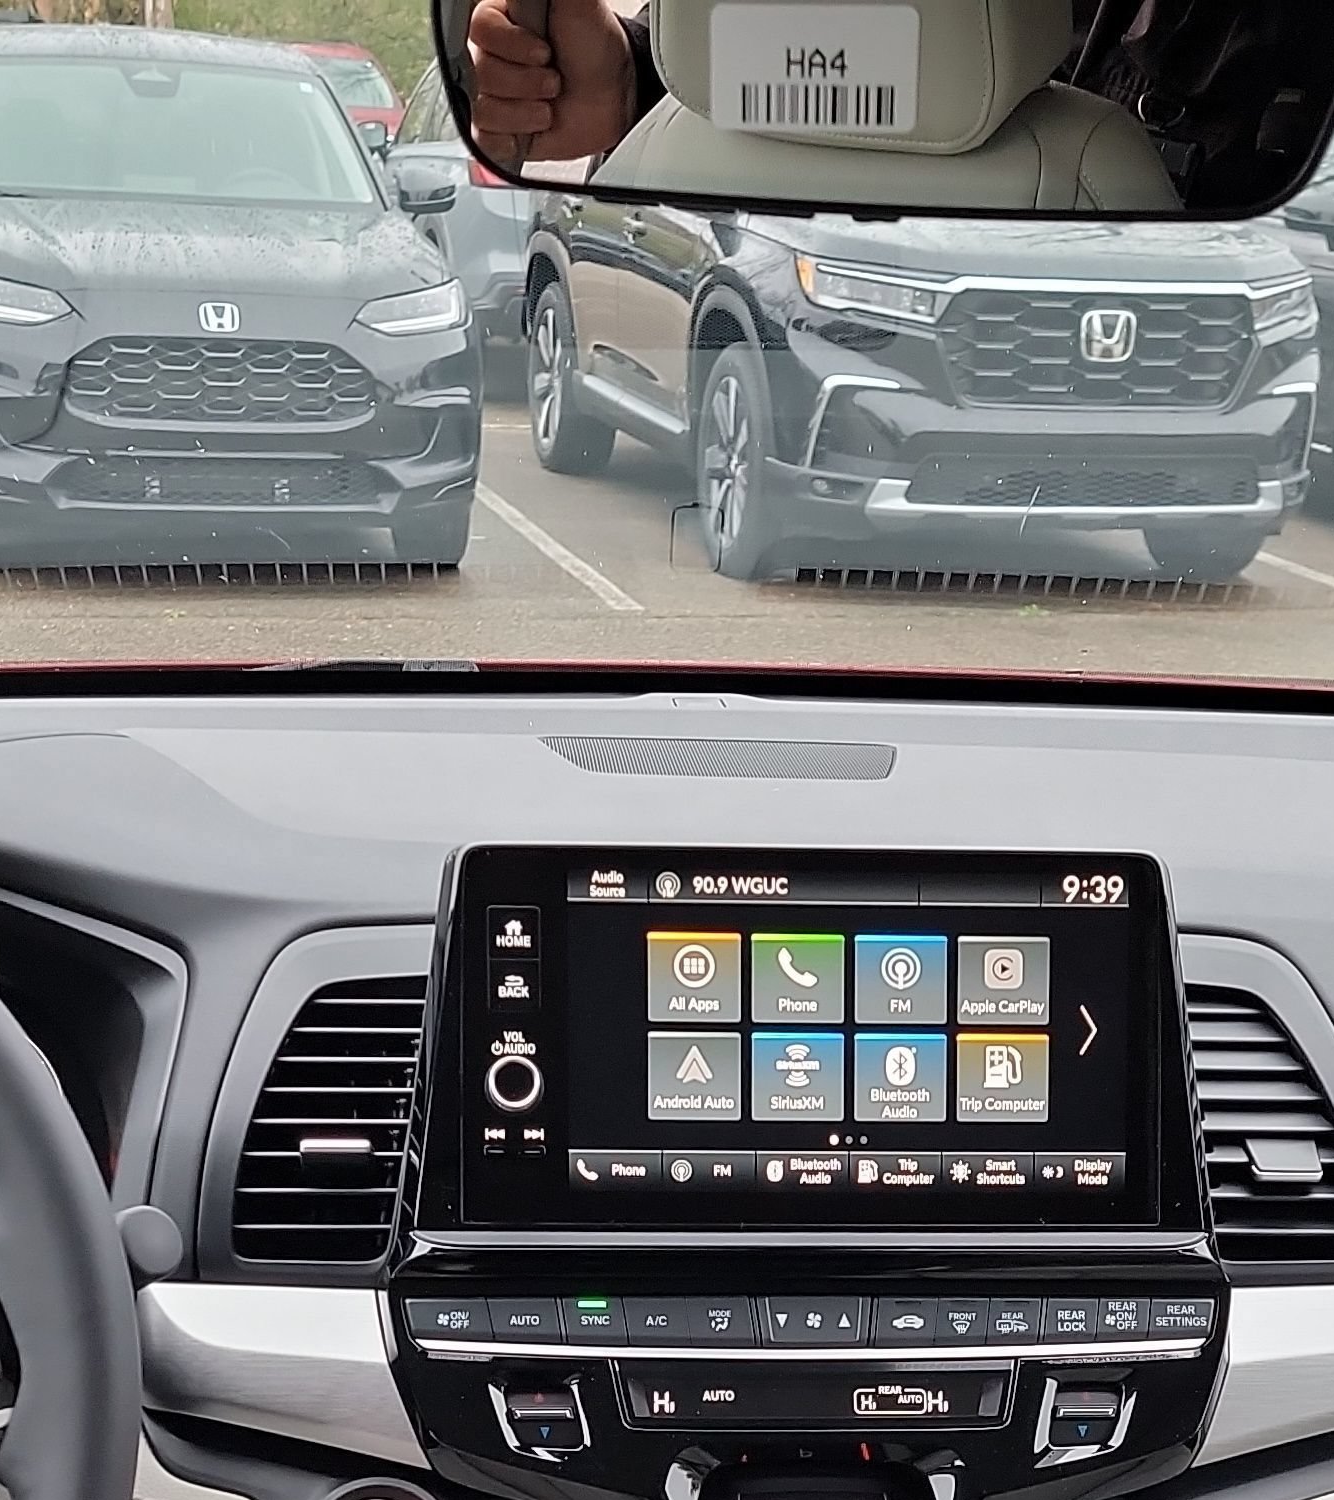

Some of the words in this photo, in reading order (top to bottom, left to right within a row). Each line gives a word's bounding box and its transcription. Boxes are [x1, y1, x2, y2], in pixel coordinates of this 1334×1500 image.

[786, 46, 848, 79] HA4
[592, 870, 624, 884] Audio
[590, 885, 626, 898] Source
[693, 876, 728, 894] 90.9
[731, 876, 788, 895] WGUC
[1063, 875, 1124, 903] 9:39
[496, 935, 531, 948] HOME
[498, 986, 529, 998] BACK
[669, 996, 687, 1011] All
[688, 998, 720, 1012] Apps
[778, 997, 818, 1012] Phone
[890, 1000, 911, 1013] FM
[961, 1000, 996, 1014] Apple
[998, 1000, 1045, 1015] CarPlay
[503, 1031, 525, 1043] VOL
[503, 1043, 536, 1055] AUDIO
[870, 1088, 930, 1103] Bluetooth
[653, 1095, 702, 1110] Android
[703, 1096, 735, 1110] Auto
[771, 1096, 824, 1110] SiriusXM
[960, 1098, 983, 1113] Trip
[985, 1099, 1045, 1113] Computer
[882, 1105, 918, 1119] Audio
[611, 1163, 646, 1177] Phone
[713, 1164, 732, 1177] FM
[790, 1158, 842, 1172] Bluetooth
[898, 1159, 918, 1173] Trip
[985, 1160, 1016, 1173] Smart
[1074, 1160, 1113, 1174] Display
[799, 1172, 832, 1185] Audio
[882, 1173, 934, 1187] Computer
[976, 1173, 1026, 1185] Shortcuts
[1077, 1173, 1108, 1185] Mode
[1108, 1301, 1137, 1312] REAR
[1166, 1305, 1196, 1316] REAR
[450, 1311, 469, 1320] ON/
[510, 1316, 539, 1325] AUTO
[646, 1315, 667, 1326] A/C
[708, 1310, 731, 1318] MODE
[948, 1312, 977, 1322] FRONT
[1001, 1311, 1024, 1320] REAR
[1057, 1310, 1086, 1322] REAR
[1116, 1311, 1137, 1321] ON/
[450, 1320, 469, 1329] OFF
[580, 1316, 610, 1326] SYNC
[1057, 1321, 1087, 1332] LOCK
[1116, 1320, 1138, 1330] OFF
[1155, 1315, 1207, 1327] SETTINGS
[702, 1389, 735, 1402] AUTO
[877, 1385, 903, 1395] REAR
[897, 1394, 923, 1405] AUTO
